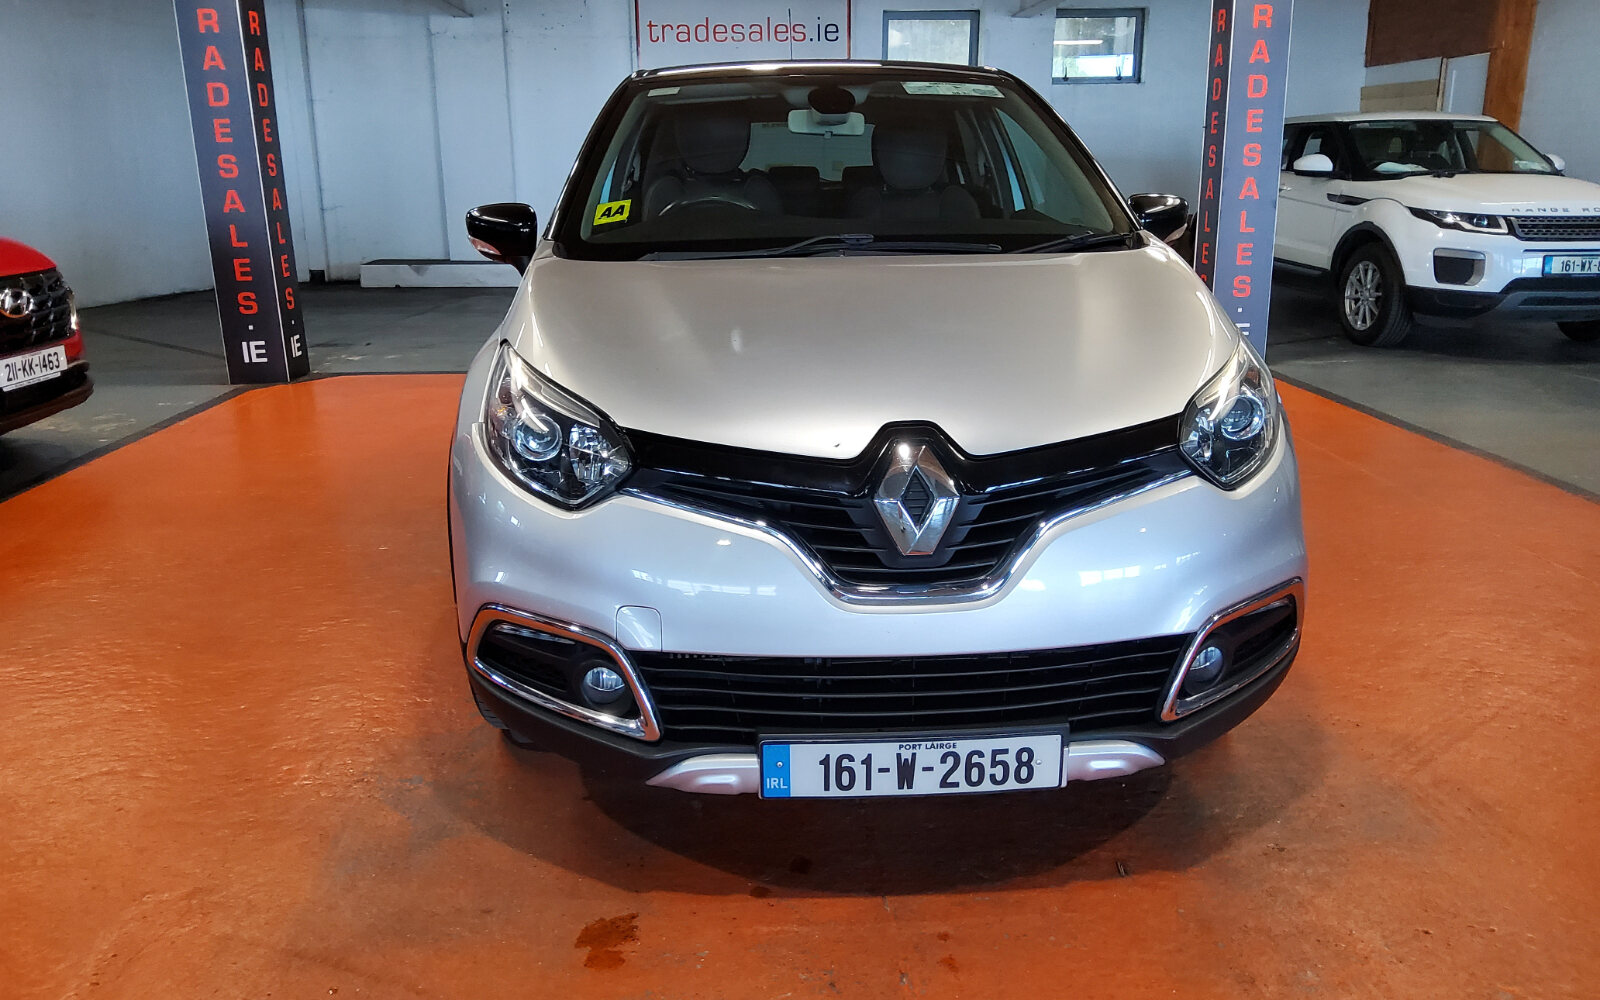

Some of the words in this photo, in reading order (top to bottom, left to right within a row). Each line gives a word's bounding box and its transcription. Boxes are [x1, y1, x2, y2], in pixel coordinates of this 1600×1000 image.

[646, 17, 839, 42] tradesales.ie
[598, 204, 625, 219] AA
[4, 351, 60, 382] 211-KK-1463
[818, 747, 1035, 791] 161-W-2658
[766, 777, 788, 789] IRL
